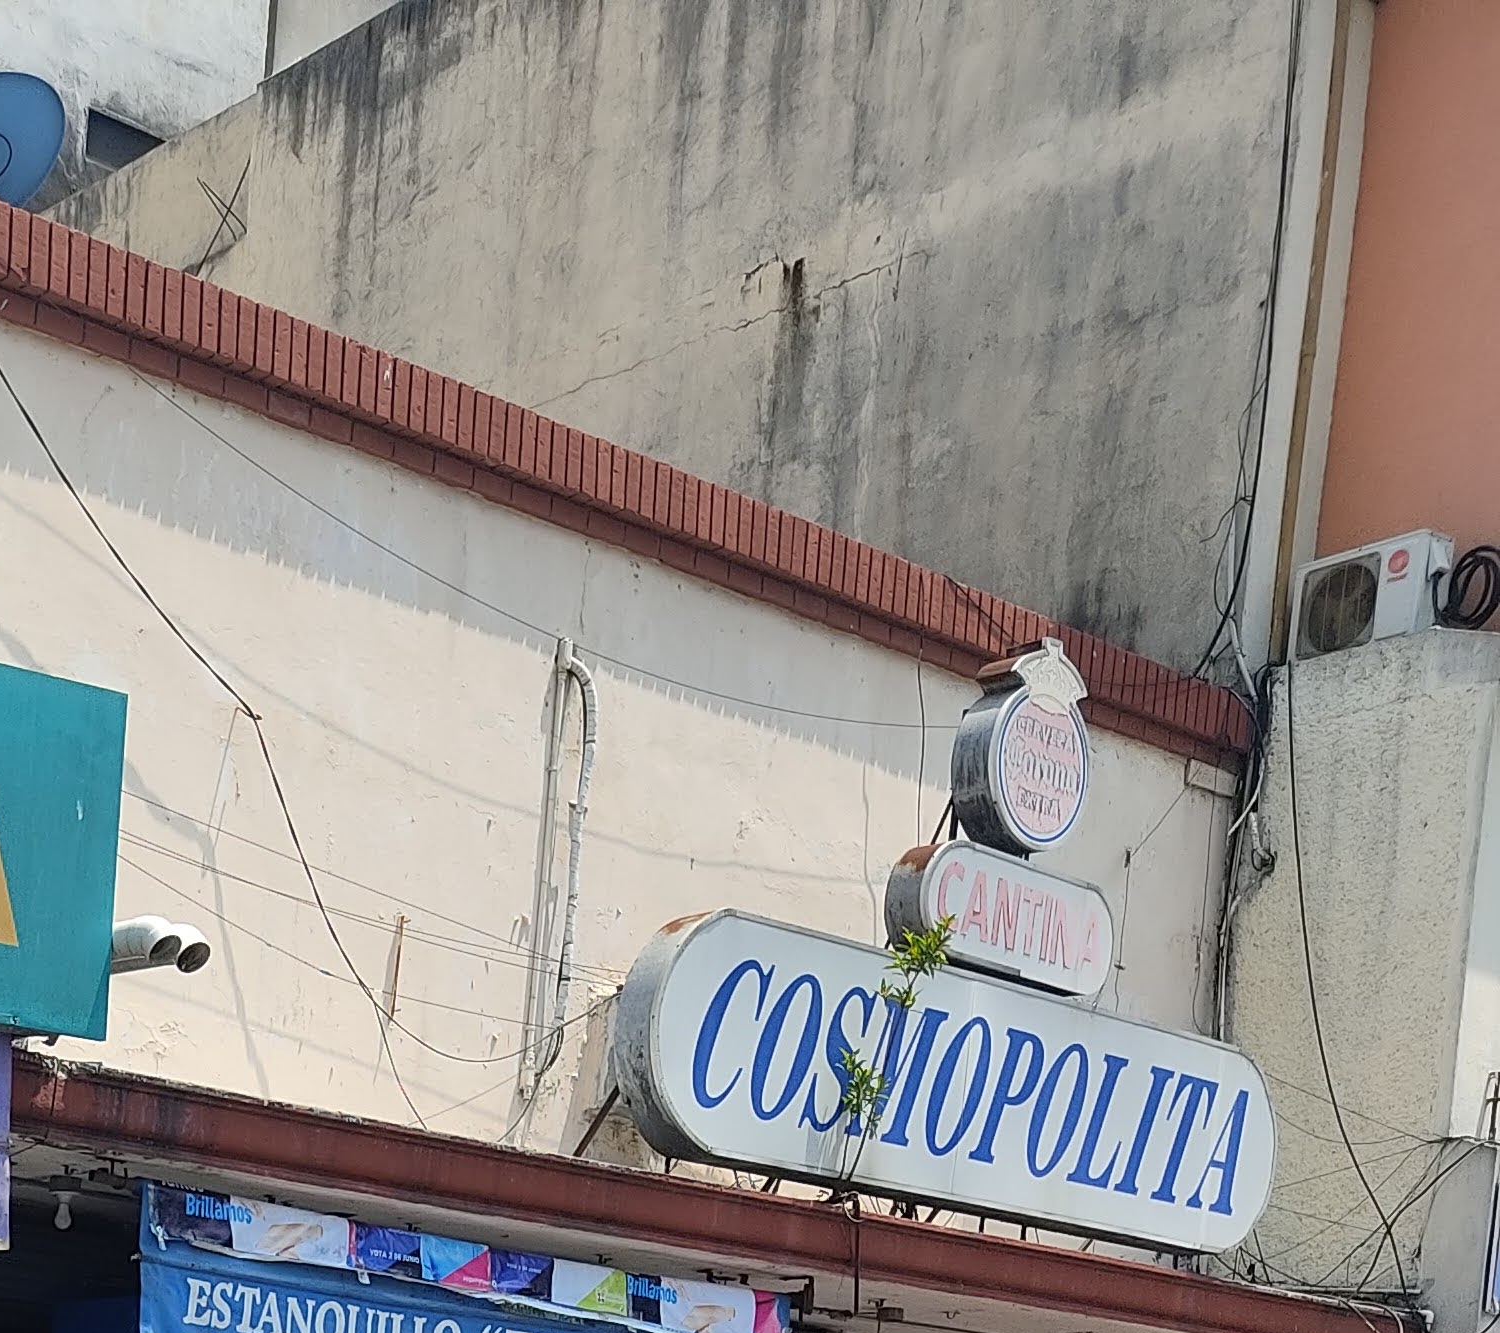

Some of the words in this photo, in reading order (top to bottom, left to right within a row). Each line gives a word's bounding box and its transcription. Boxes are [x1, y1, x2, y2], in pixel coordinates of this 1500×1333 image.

[1015, 716, 1075, 755] CERVEZA
[1017, 786, 1061, 822] EXTRA
[937, 861, 1101, 972] CANTINA
[691, 959, 1249, 1216] COSMOPOLITA
[185, 1193, 253, 1224] Brillamos
[369, 1248, 387, 1259] VOTA
[626, 1275, 678, 1304] Brillamos
